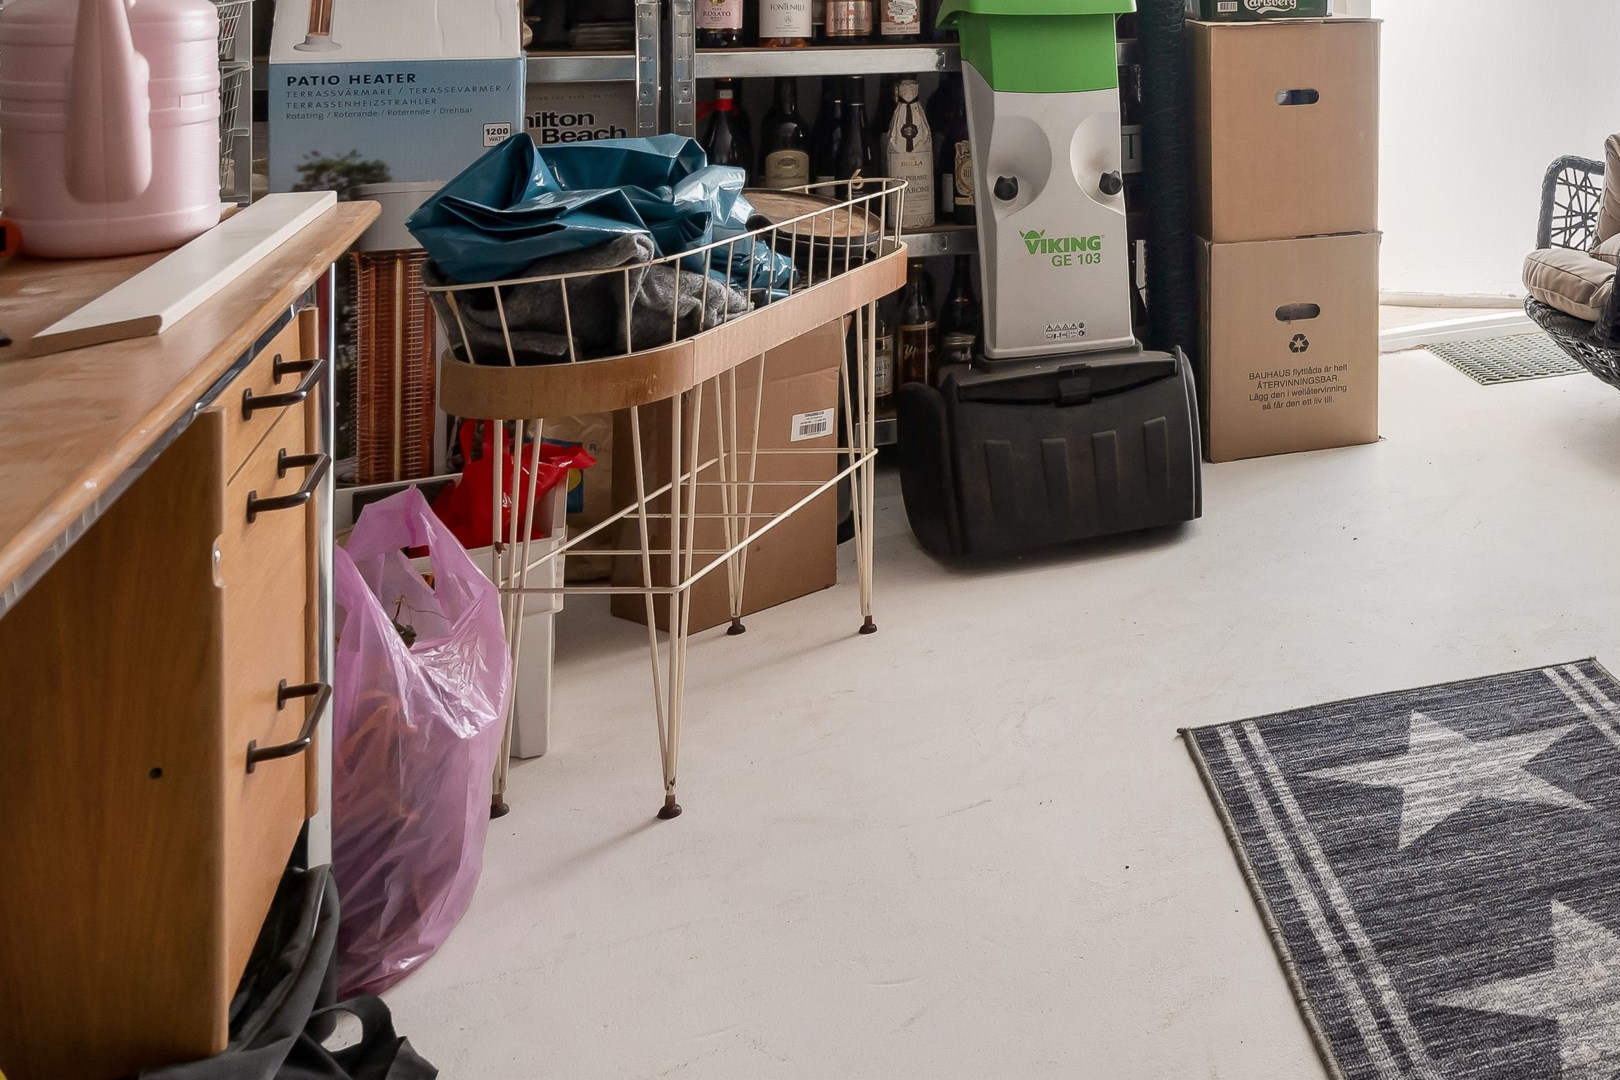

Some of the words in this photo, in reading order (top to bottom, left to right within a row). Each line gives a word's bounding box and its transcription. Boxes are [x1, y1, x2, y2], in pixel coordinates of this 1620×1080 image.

[286, 75, 341, 86] PATIO
[349, 73, 416, 85] HEATER
[286, 88, 392, 98] TERRASSVÄRMARE
[286, 98, 436, 109] TERRASSENHEIZSTRAHLER
[286, 112, 324, 120] Rotating
[334, 110, 378, 118] Roterande
[486, 128, 509, 136] 1200
[542, 126, 627, 144] Beach
[1024, 236, 1102, 254] VIKING
[1052, 253, 1072, 267] GE
[1077, 252, 1101, 266] 103
[1249, 370, 1290, 380] BAUHAUS
[1292, 367, 1322, 378] flyttlåda
[1324, 366, 1332, 374] är
[1333, 364, 1348, 372] helt
[1257, 376, 1340, 390] ÅTERVINNINGSBAR.
[1249, 391, 1268, 402] Lägg
[1271, 390, 1285, 399] den
[1292, 385, 1347, 397] wellåtervinning
[1262, 401, 1271, 410] så
[1274, 400, 1284, 409] får
[1286, 400, 1300, 408] den
